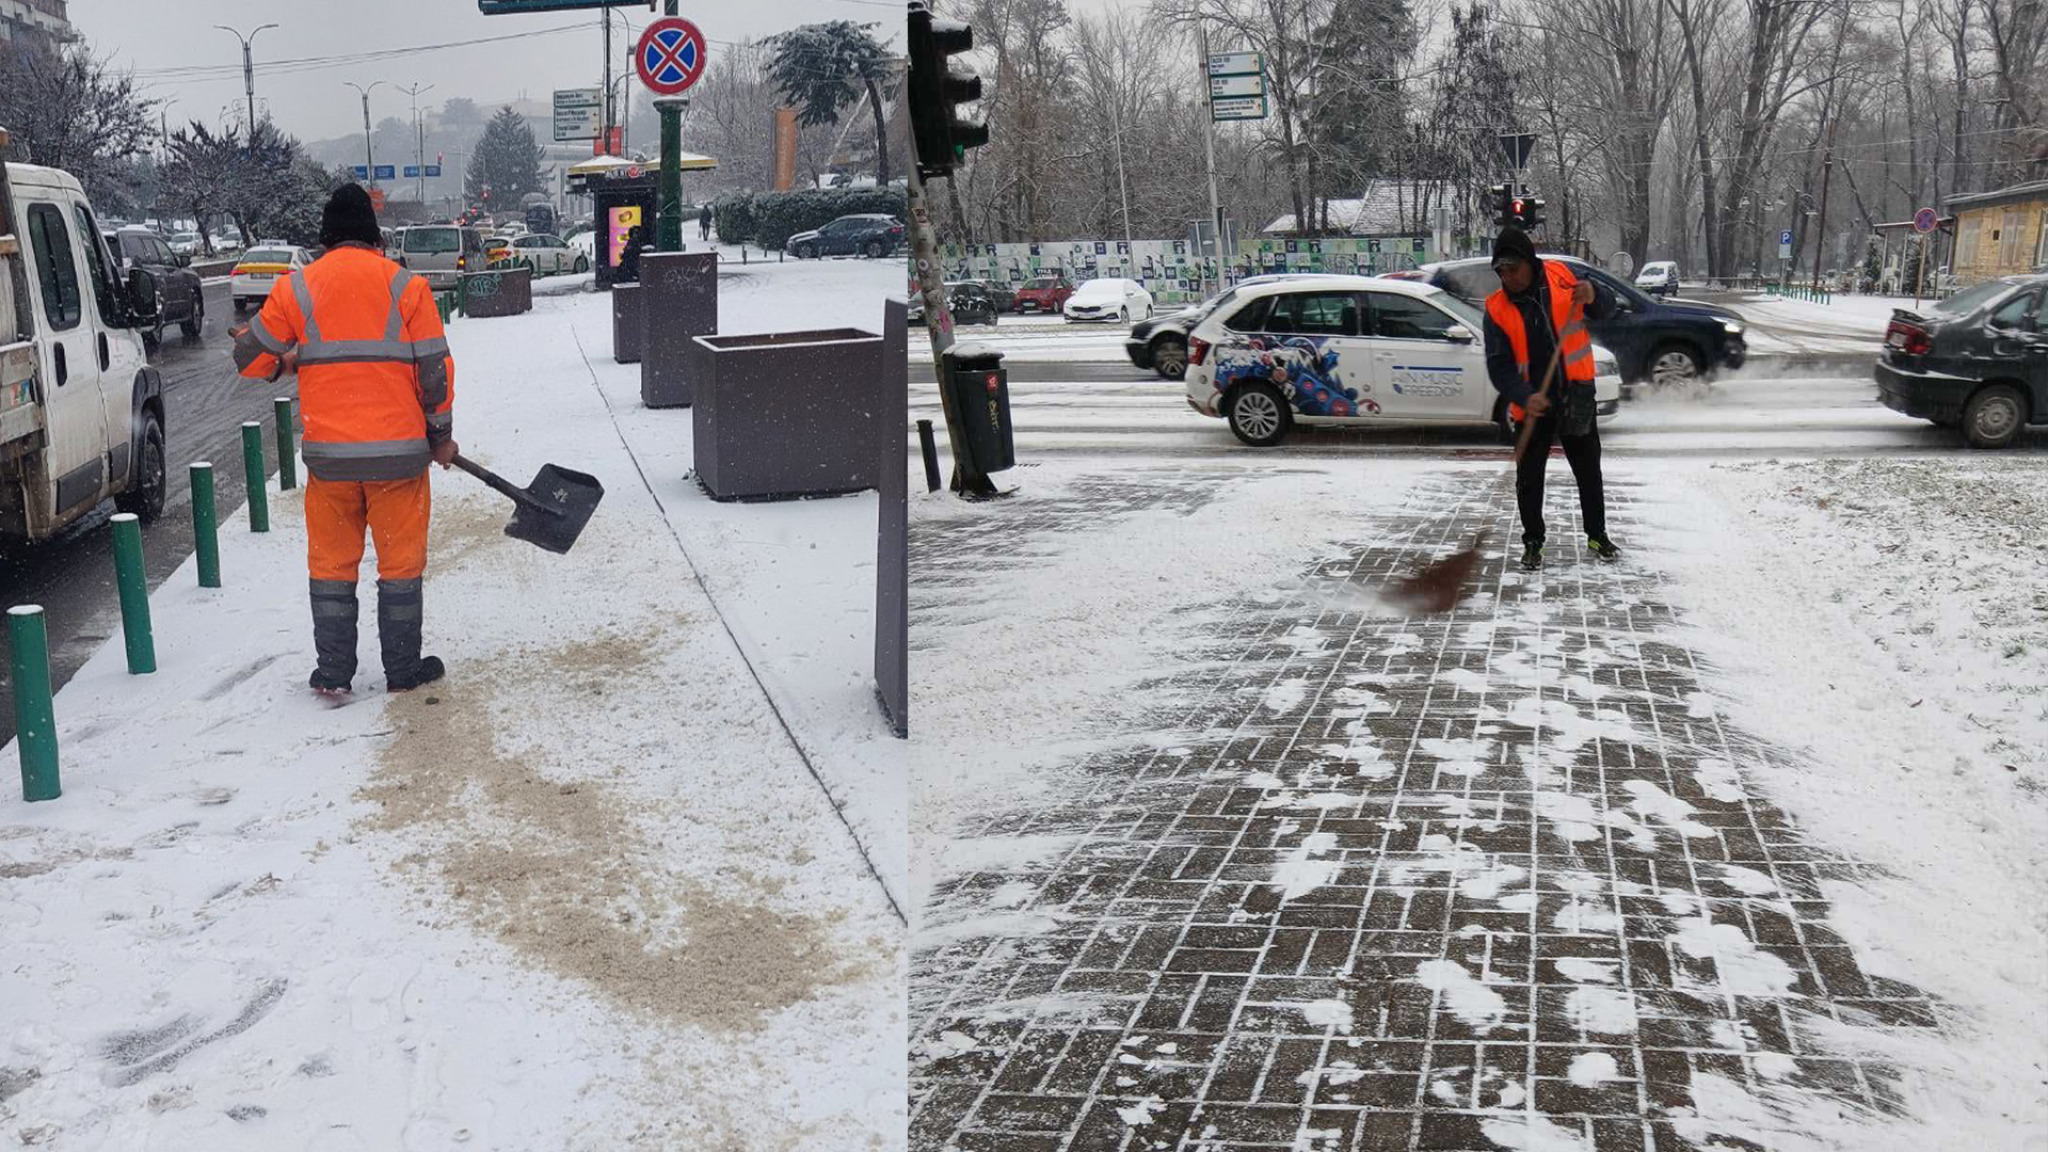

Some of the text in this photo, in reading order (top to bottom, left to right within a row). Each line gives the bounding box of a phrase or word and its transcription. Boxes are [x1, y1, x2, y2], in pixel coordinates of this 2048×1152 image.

[1782, 232, 1790, 243] P
[1420, 372, 1463, 386] MUSIC
[1403, 384, 1463, 397] FREEDOM
